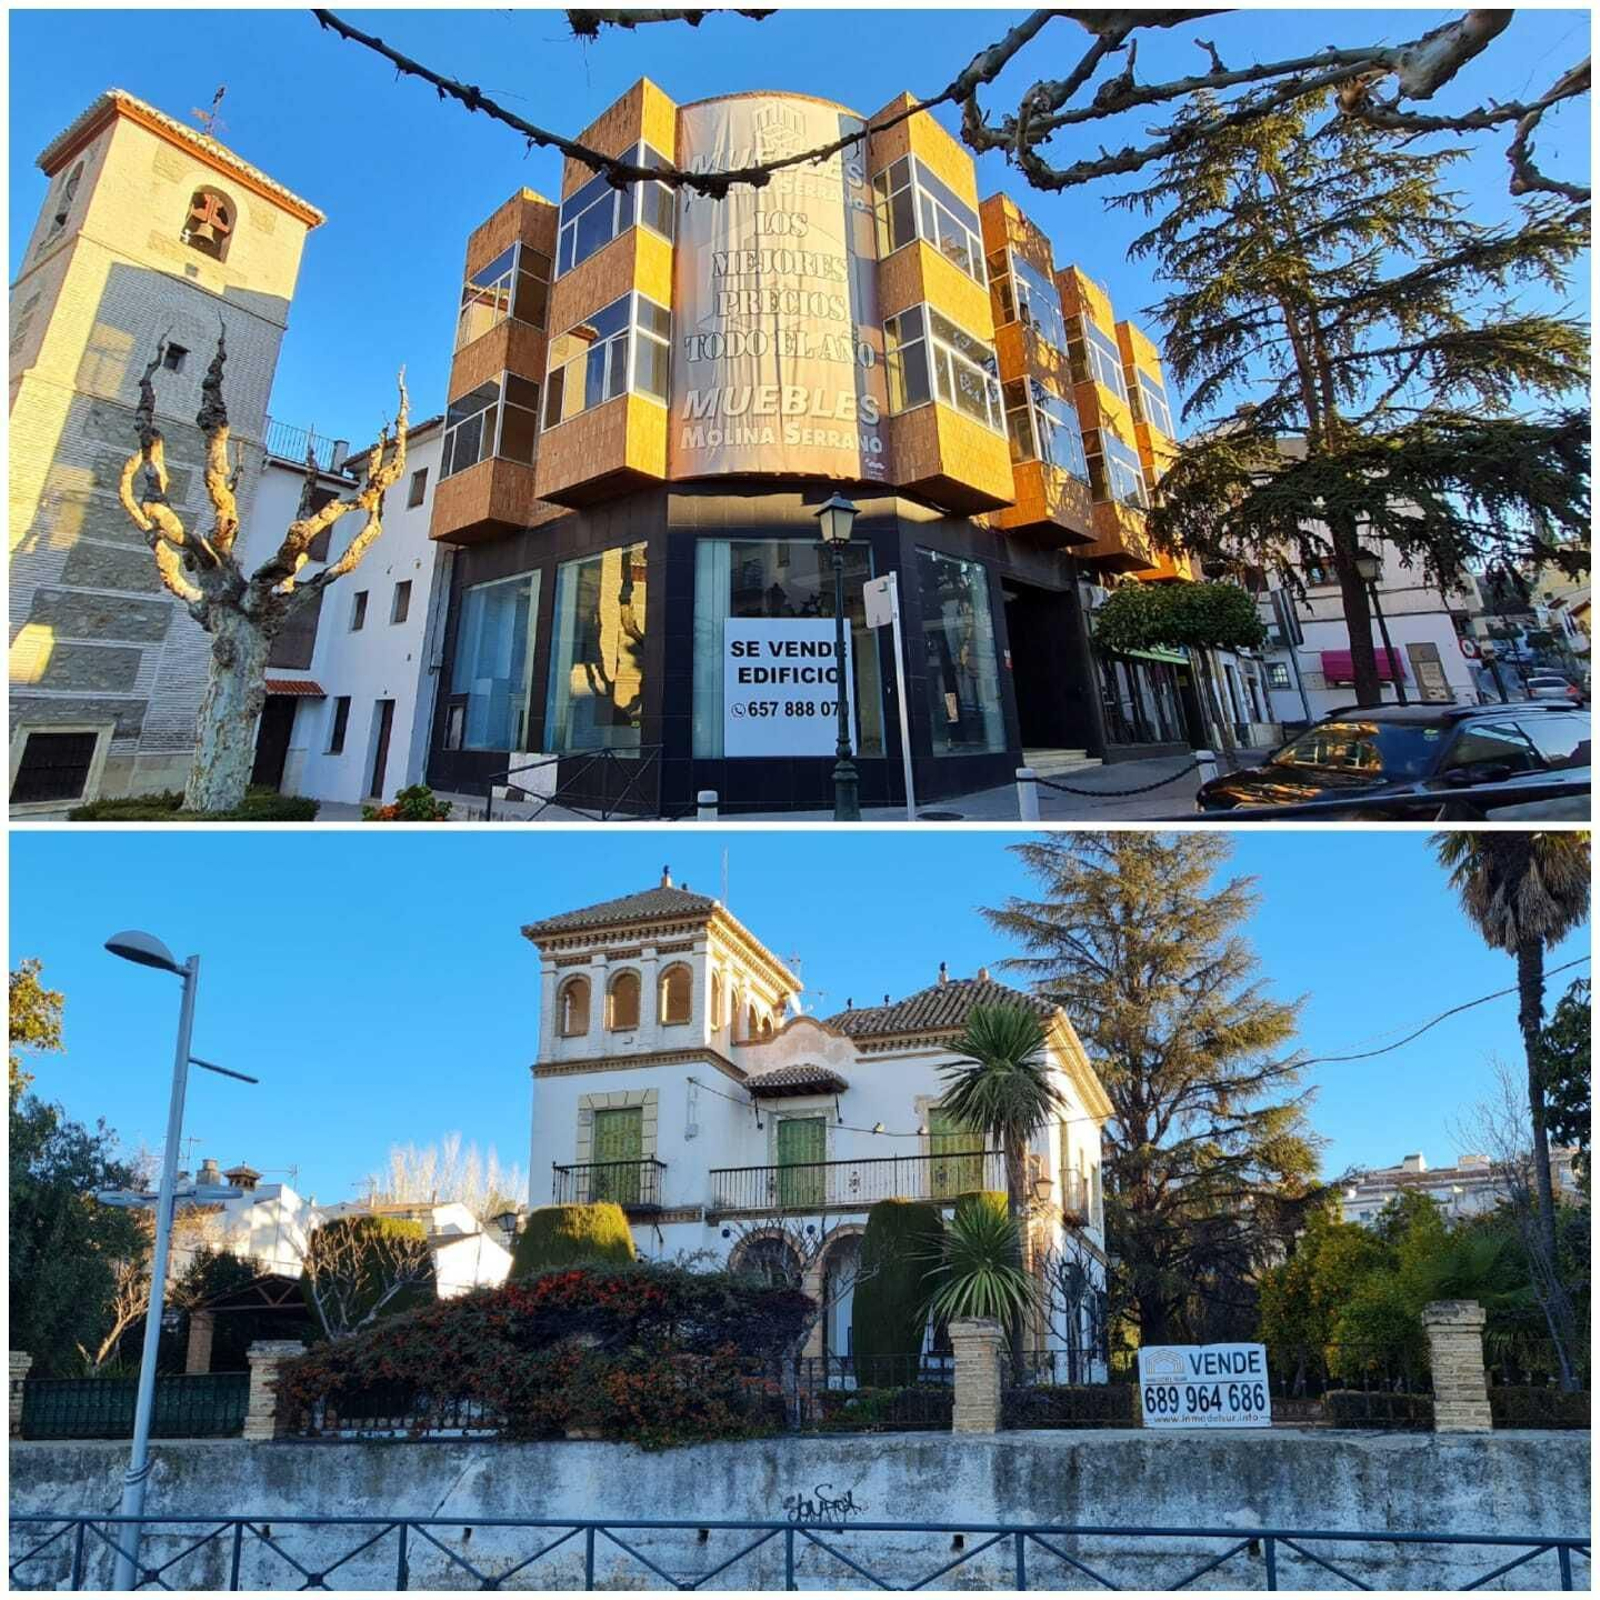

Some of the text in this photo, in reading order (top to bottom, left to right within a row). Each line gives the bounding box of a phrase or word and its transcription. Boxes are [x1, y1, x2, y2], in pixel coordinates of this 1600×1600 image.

[754, 210, 808, 238] LOS
[712, 249, 848, 283] MEJORES
[717, 288, 847, 321] PRECIOS
[684, 328, 875, 369] TODO EL AÑO
[682, 383, 880, 426] MUEBLES
[680, 421, 883, 454] MOLINA SERRANO
[730, 641, 760, 658] SE
[738, 667, 840, 684] EDIFICIO
[749, 701, 848, 717] 657 888 07
[1189, 1351, 1261, 1376] VENDE
[1145, 1384, 1265, 1414] 689 964 686
